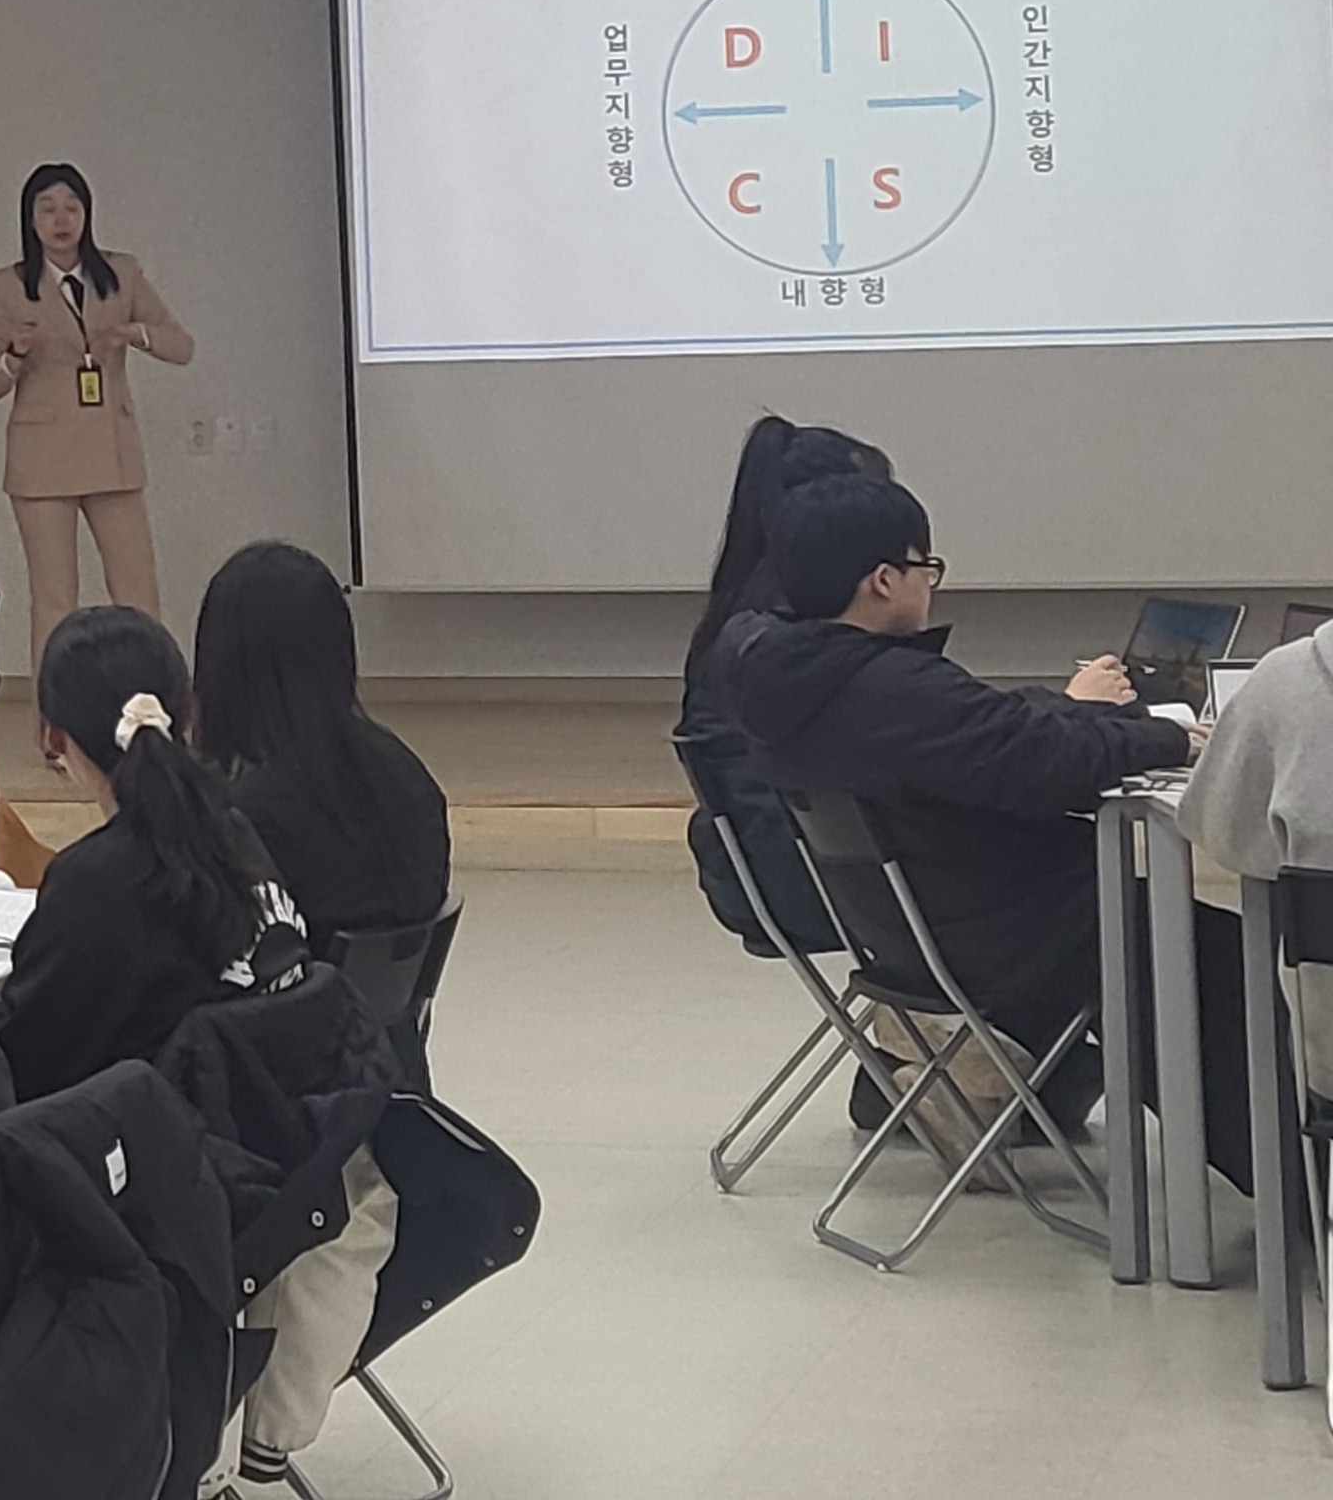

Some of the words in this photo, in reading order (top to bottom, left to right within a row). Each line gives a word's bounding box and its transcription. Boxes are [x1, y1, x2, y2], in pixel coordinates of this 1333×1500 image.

[724, 27, 762, 68] D
[603, 23, 635, 190] 업무지향형
[1023, 5, 1056, 174] 인간지향형
[728, 173, 761, 214] C
[873, 167, 903, 210] S
[781, 276, 886, 308] 내향형
